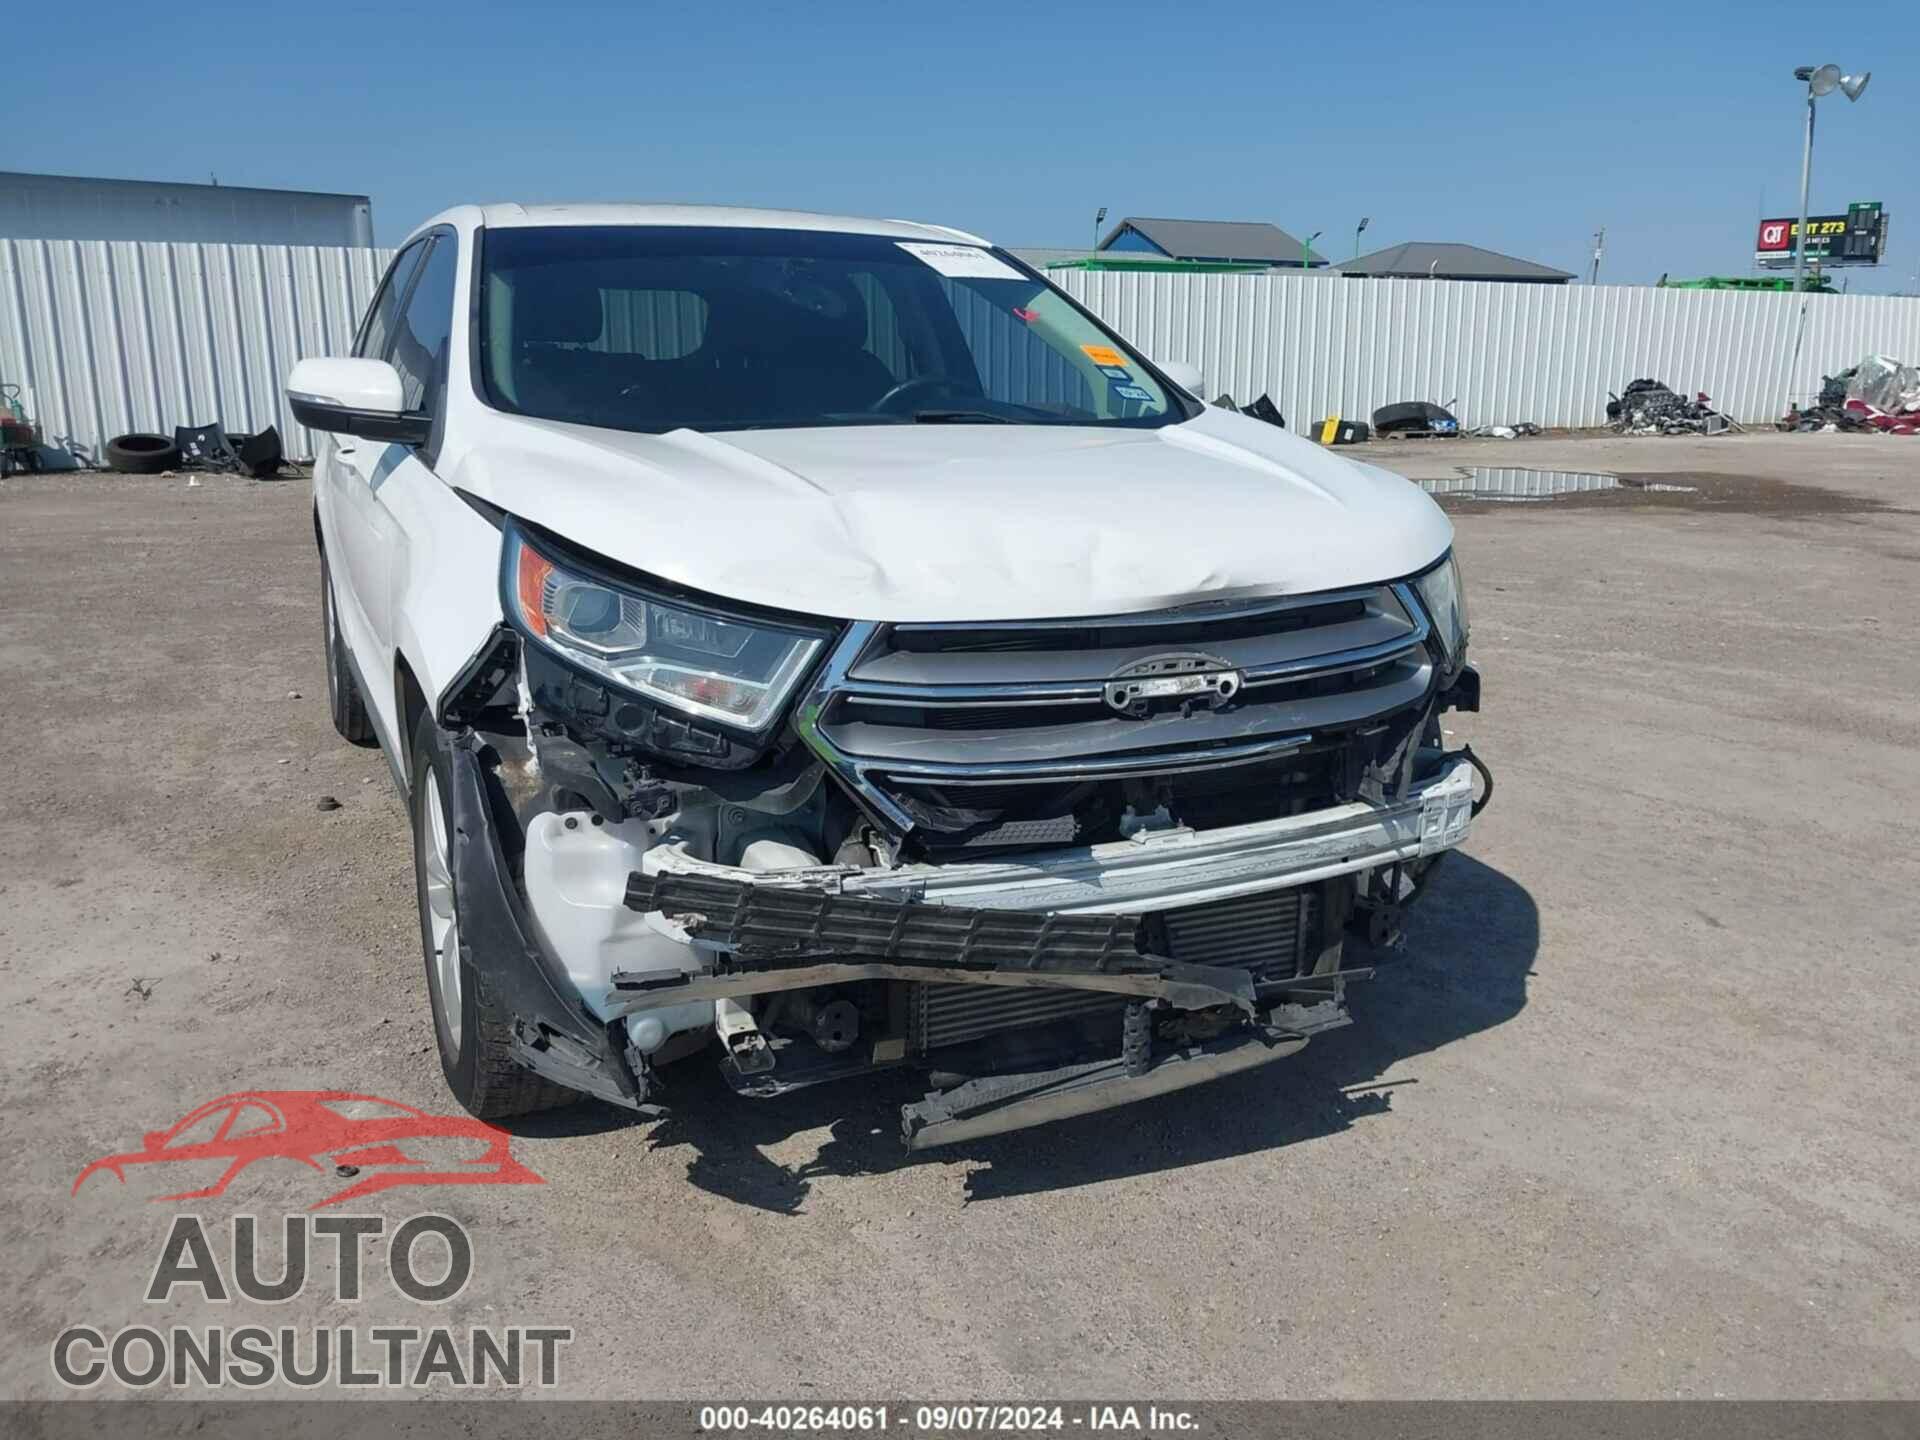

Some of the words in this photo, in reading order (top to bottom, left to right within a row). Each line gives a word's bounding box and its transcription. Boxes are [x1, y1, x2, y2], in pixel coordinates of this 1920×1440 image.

[1763, 225, 1785, 244] QT
[1791, 223, 1819, 235] EIT
[1820, 221, 1845, 234] 273
